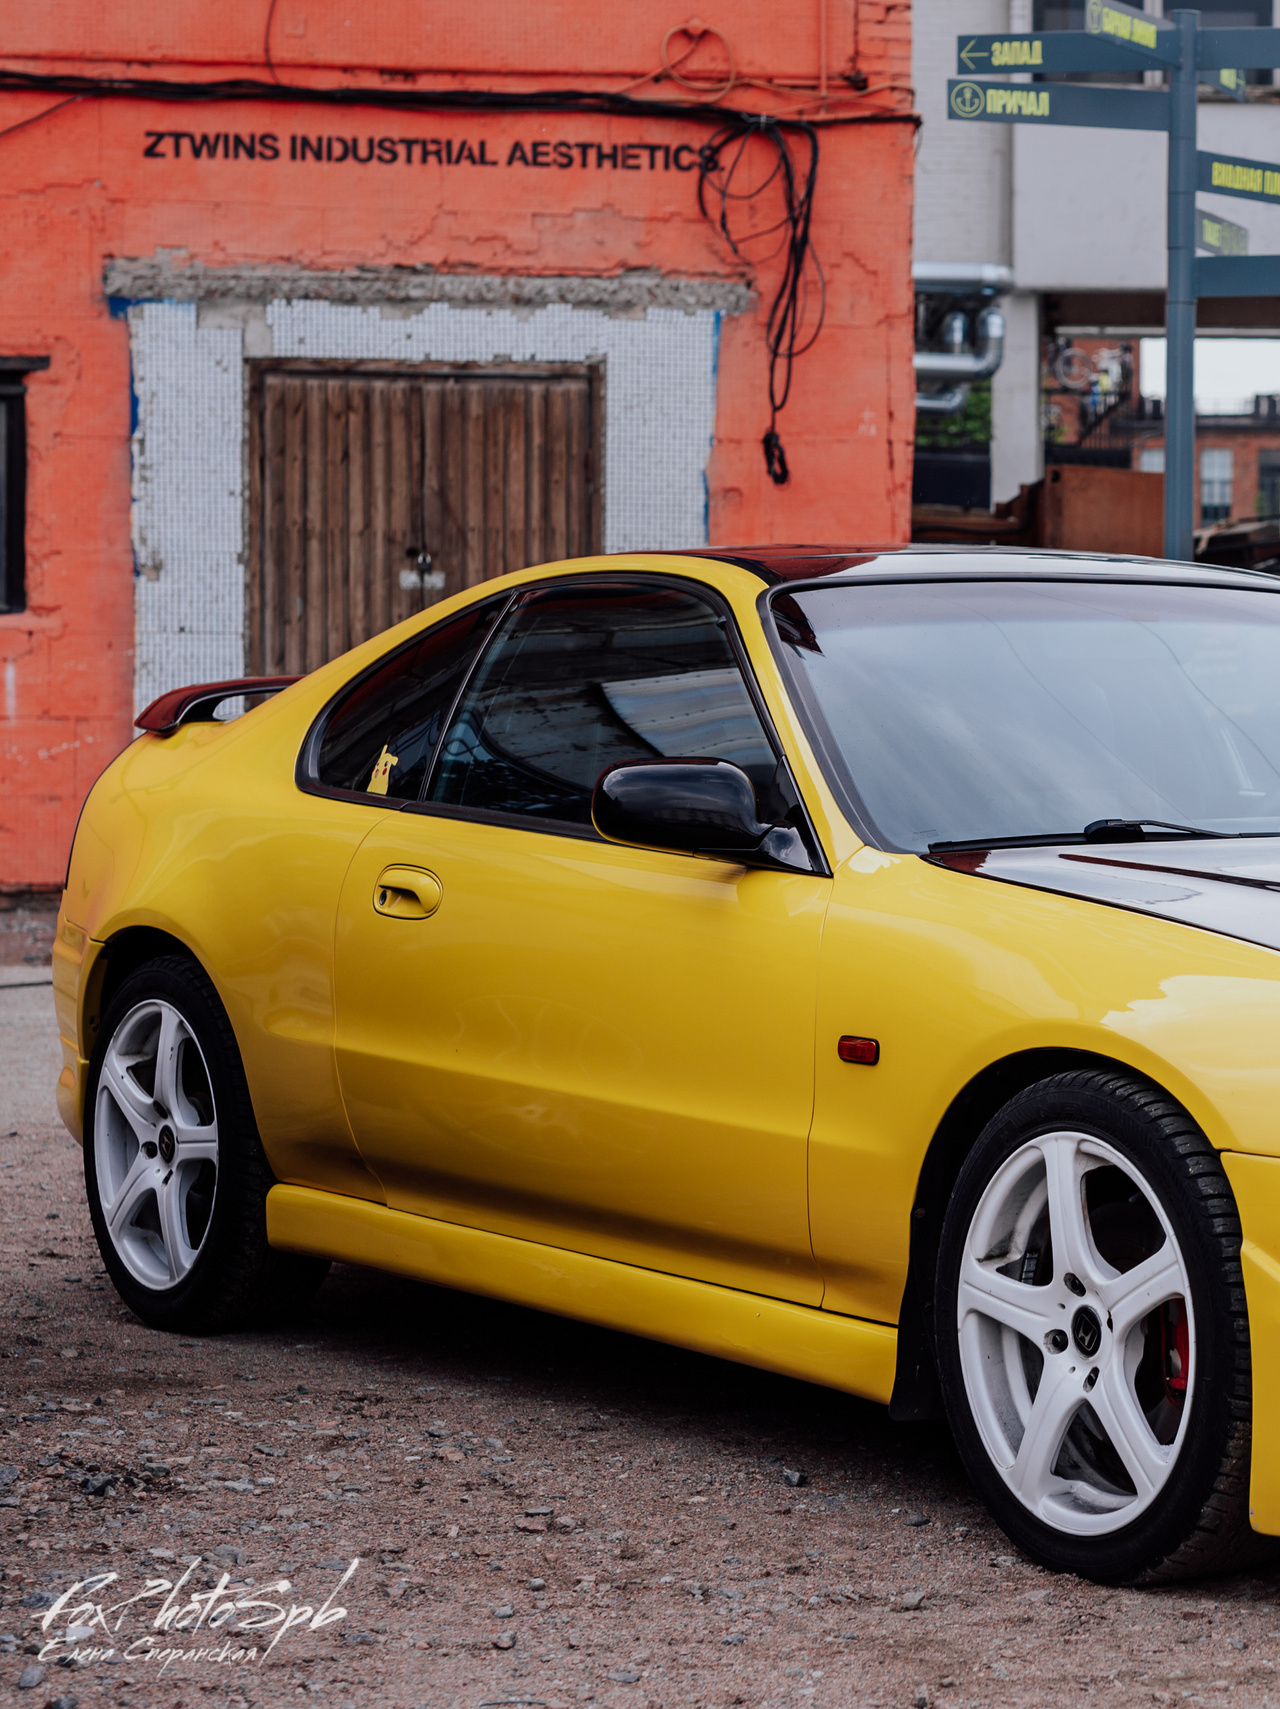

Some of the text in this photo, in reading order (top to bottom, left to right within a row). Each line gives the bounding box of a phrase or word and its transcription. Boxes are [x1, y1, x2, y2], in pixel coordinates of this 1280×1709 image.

[991, 40, 1043, 67] ЗАПАД
[986, 88, 1050, 117] ПРИЧАЛ
[143, 130, 279, 161] ZTWINS
[290, 133, 498, 166] INDUSTRIAL
[1212, 161, 1263, 193] ВХОДНАЯ
